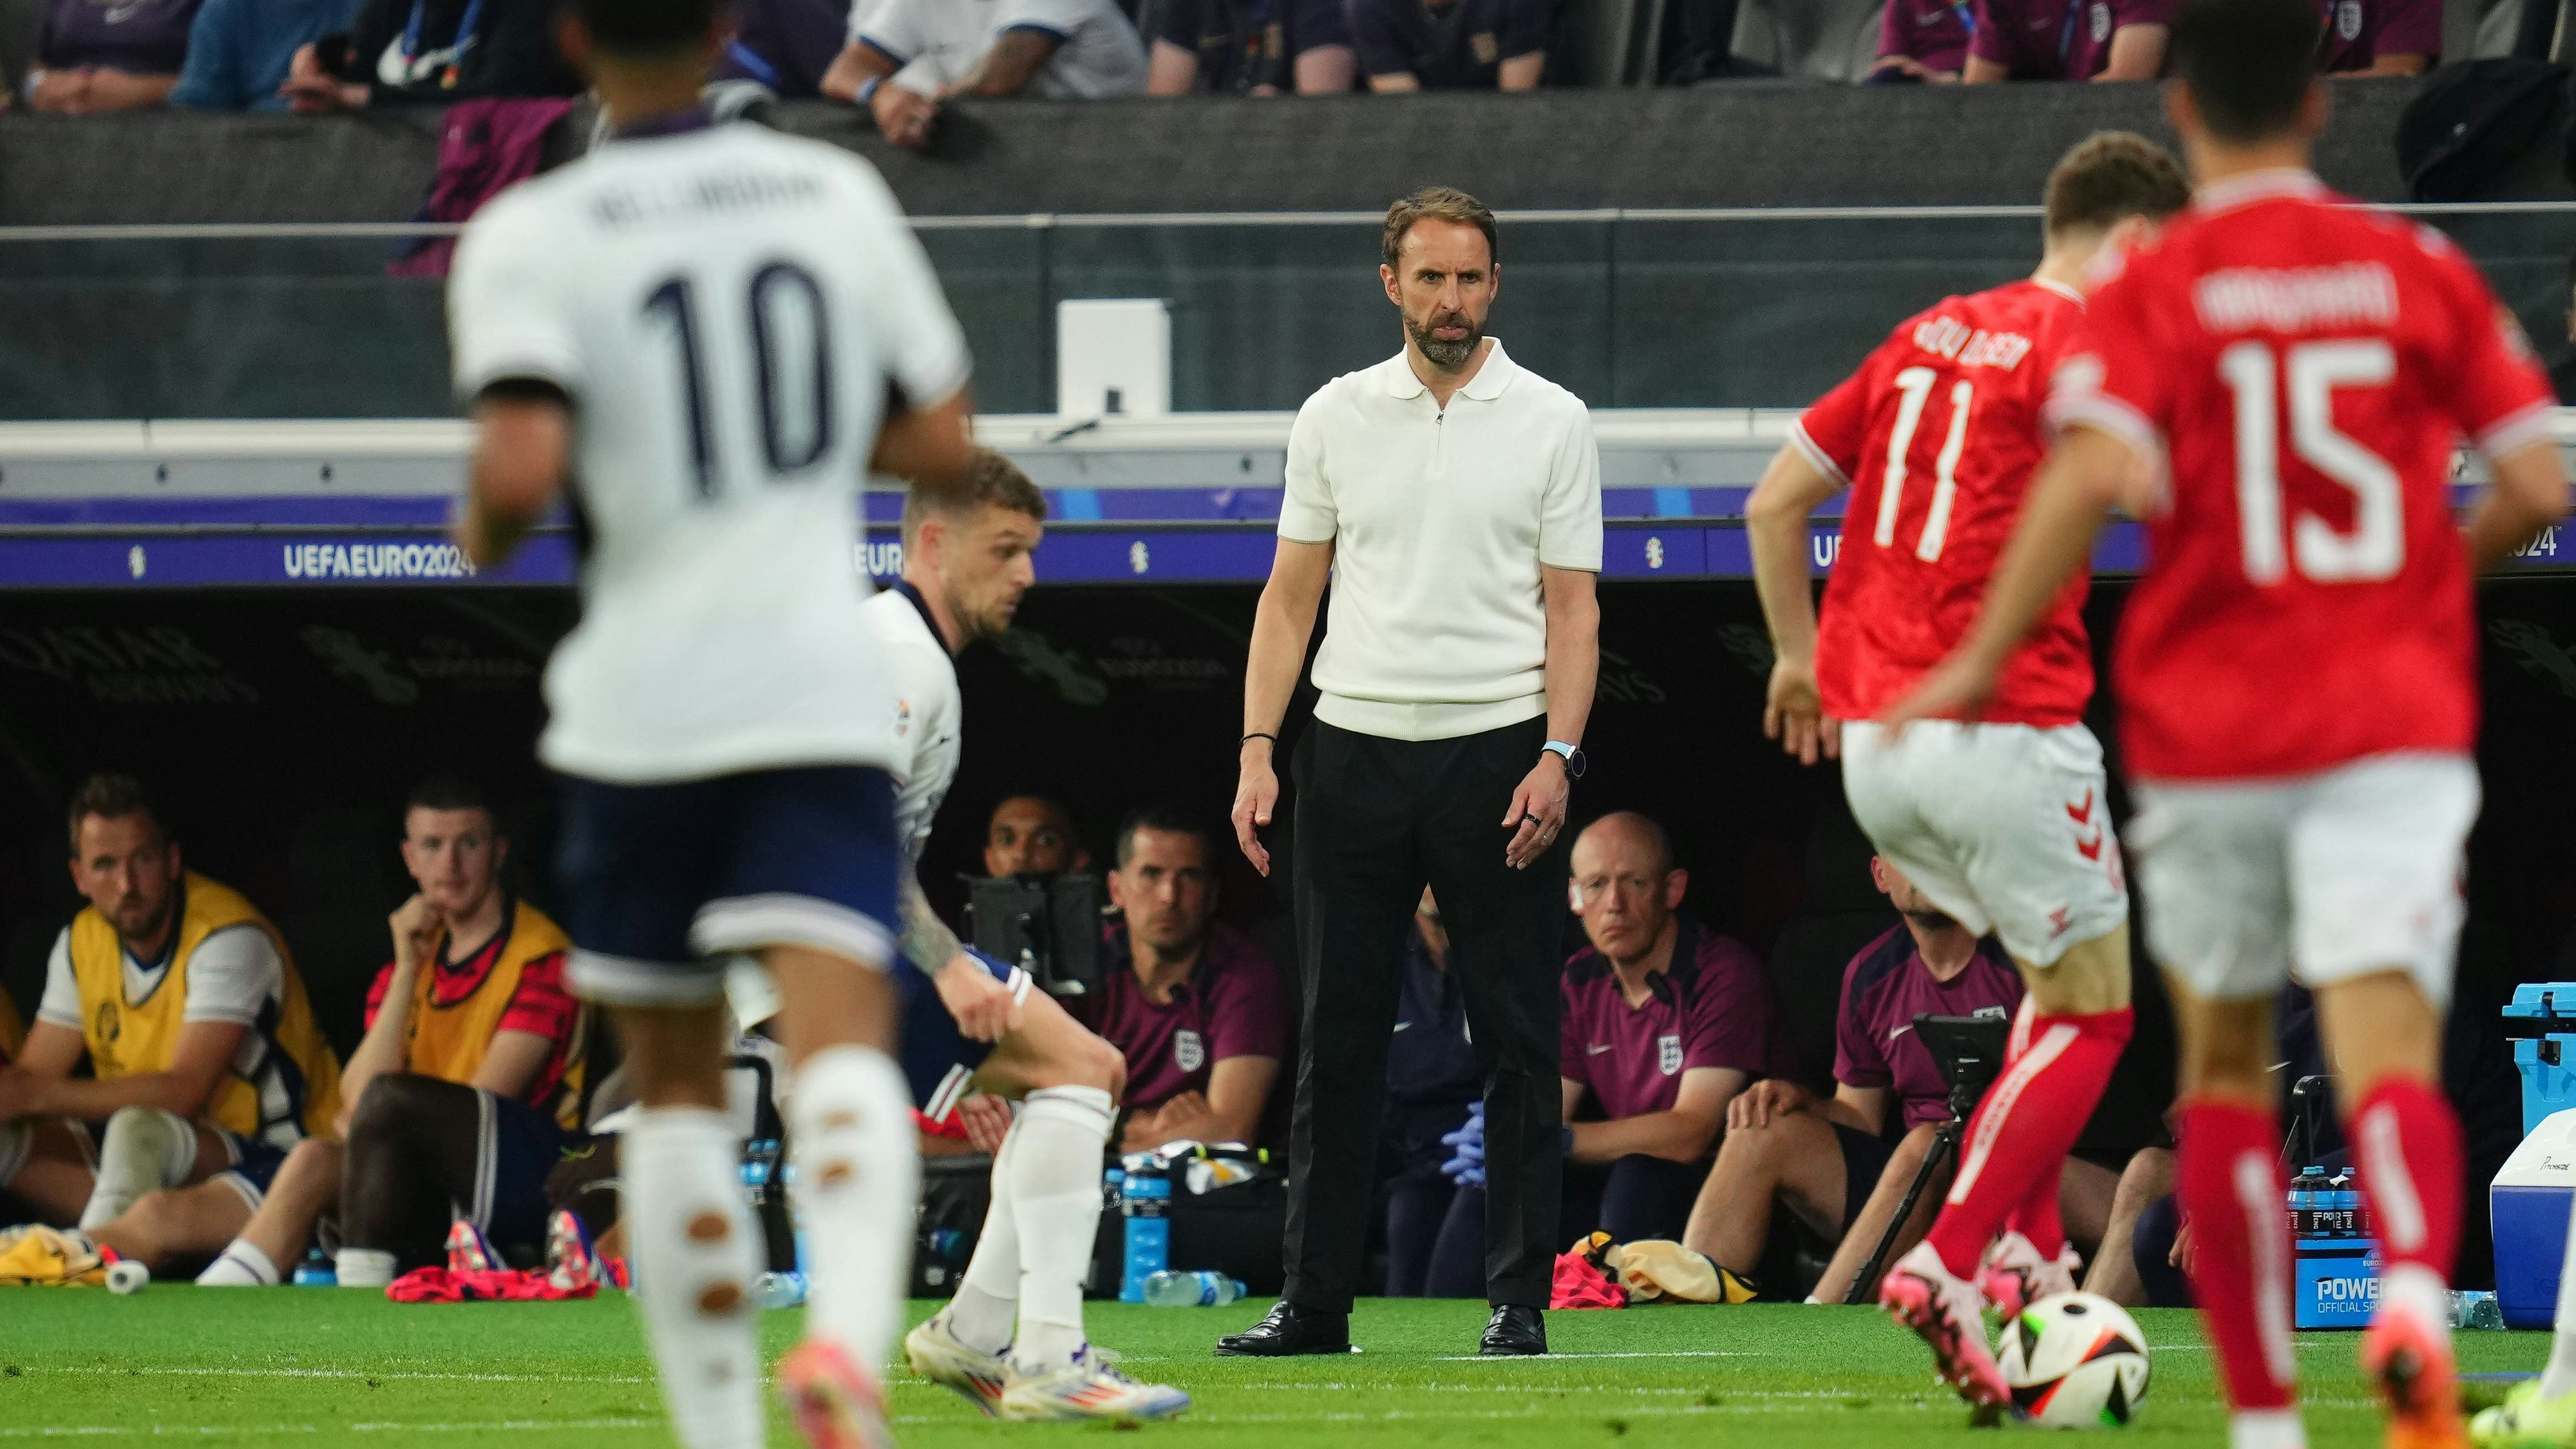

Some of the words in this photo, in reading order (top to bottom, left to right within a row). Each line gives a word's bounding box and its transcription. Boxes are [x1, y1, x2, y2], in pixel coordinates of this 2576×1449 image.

[643, 260, 835, 502] 10
[1873, 366, 1973, 563] 11
[2217, 337, 2405, 586] 15
[2318, 1302, 2361, 1313] OFFICIAL
